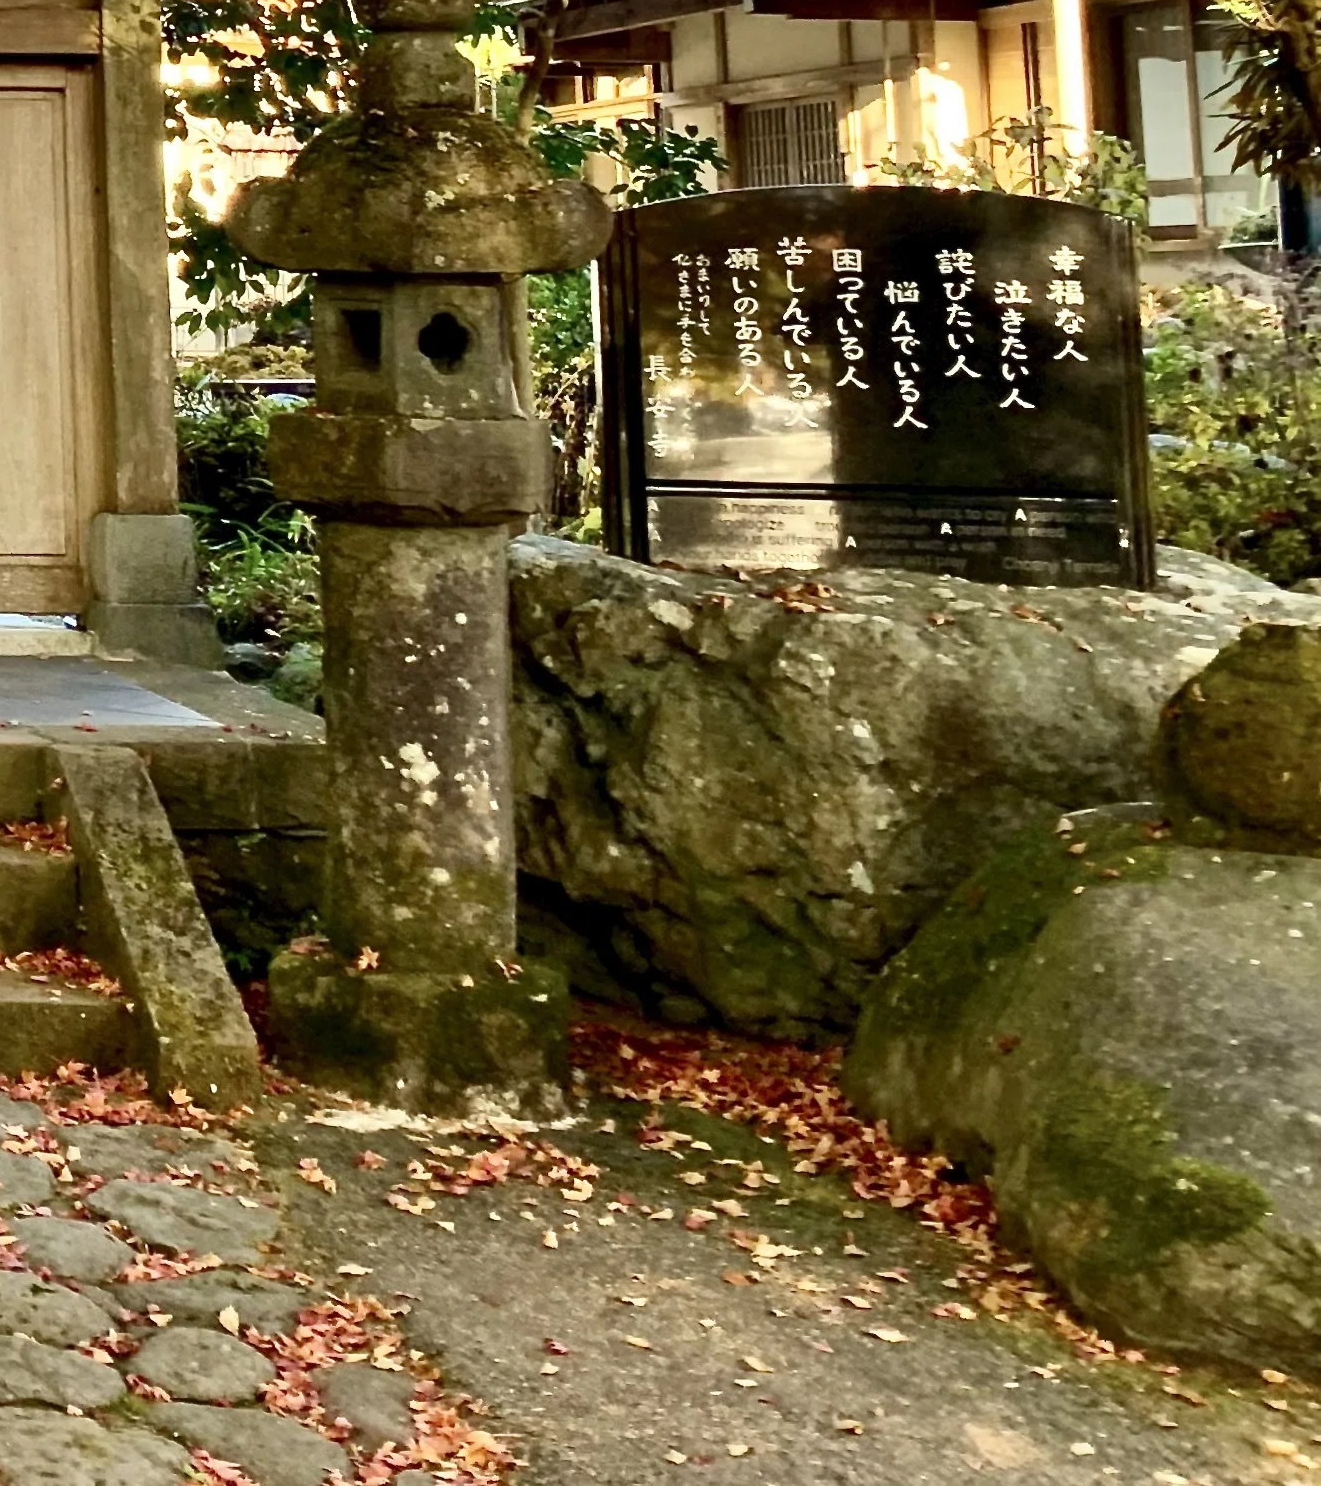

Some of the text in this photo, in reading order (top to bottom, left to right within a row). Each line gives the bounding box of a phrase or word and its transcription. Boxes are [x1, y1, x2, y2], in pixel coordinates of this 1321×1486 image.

[723, 247, 765, 397] 願いのある人
[776, 236, 819, 428] 苦しんでいる人
[832, 249, 870, 389] 困っている人
[883, 280, 929, 429] 悩んでいる人
[935, 249, 981, 378] 詫びたい人
[994, 280, 1036, 409] 泣きたい人
[1045, 245, 1089, 362] 幸福な人
[643, 355, 675, 458] 長安寺
